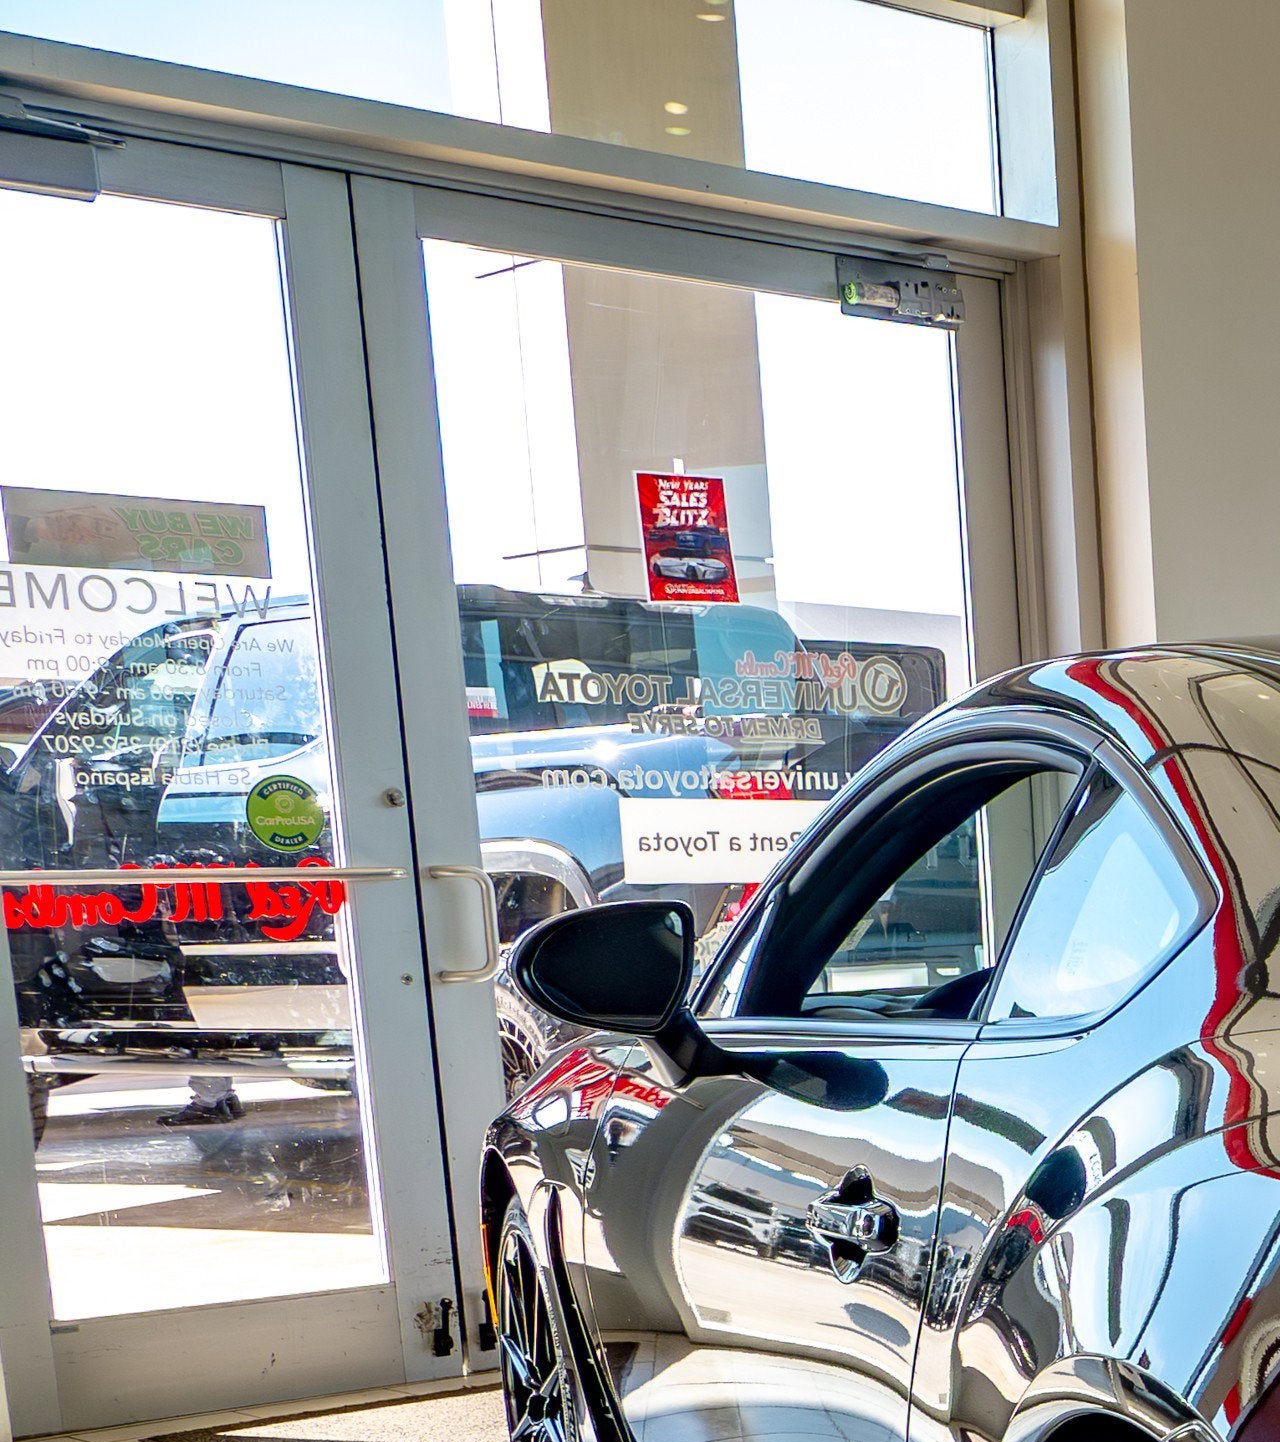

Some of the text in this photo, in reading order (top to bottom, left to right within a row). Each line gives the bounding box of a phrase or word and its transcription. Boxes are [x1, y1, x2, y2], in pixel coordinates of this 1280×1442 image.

[659, 490, 708, 508] SALES
[655, 507, 711, 527] BLITZ
[262, 782, 304, 796] CERTIFIED
[255, 815, 316, 826] CarProUSA
